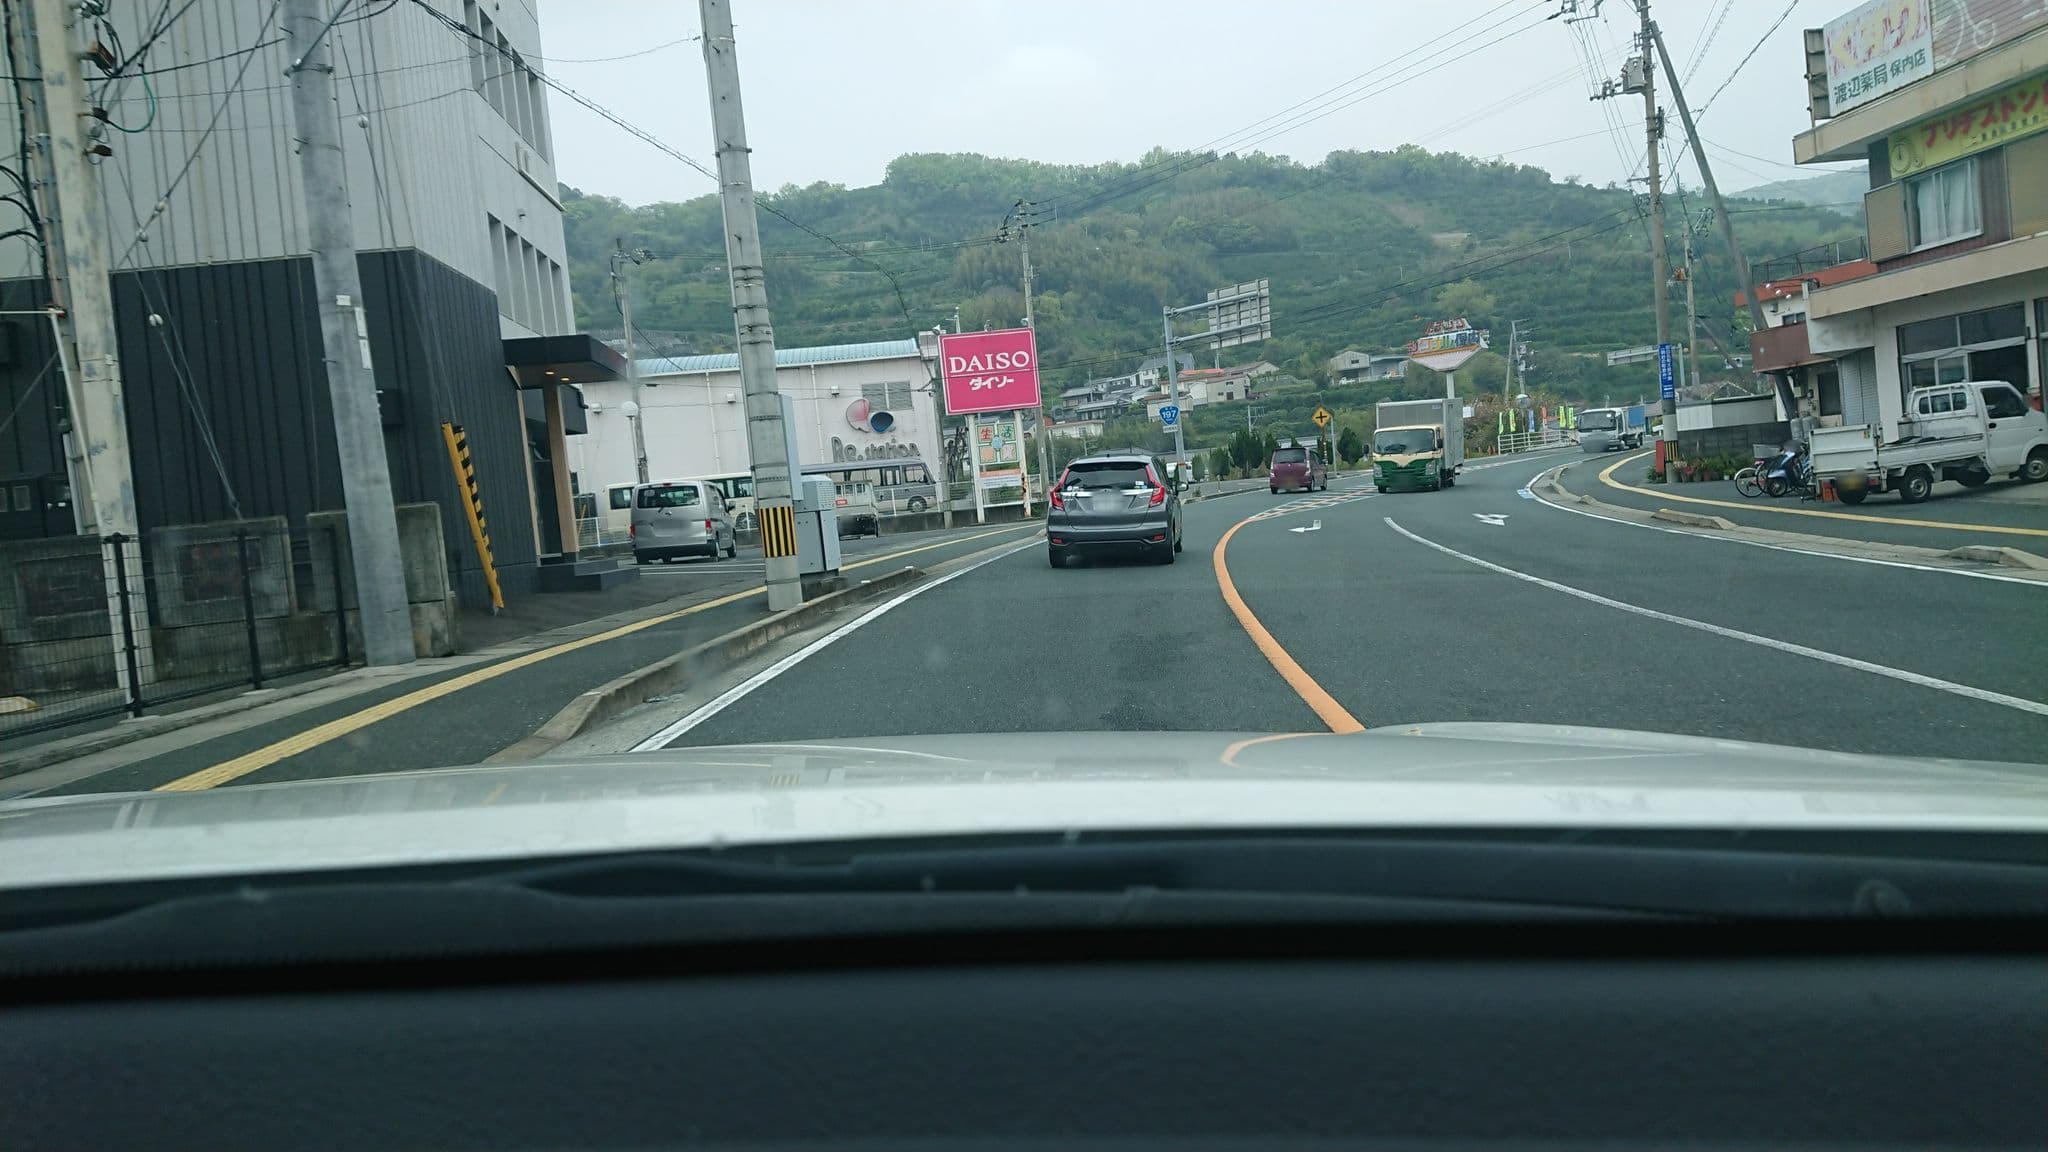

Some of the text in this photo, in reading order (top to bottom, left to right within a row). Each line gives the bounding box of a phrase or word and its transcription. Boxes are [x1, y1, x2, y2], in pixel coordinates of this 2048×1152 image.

[1834, 48, 1926, 104] 渡辺薬局 保内店
[949, 351, 1030, 373] DAISO
[969, 376, 1014, 391] ダイソー
[1162, 410, 1176, 419] 197
